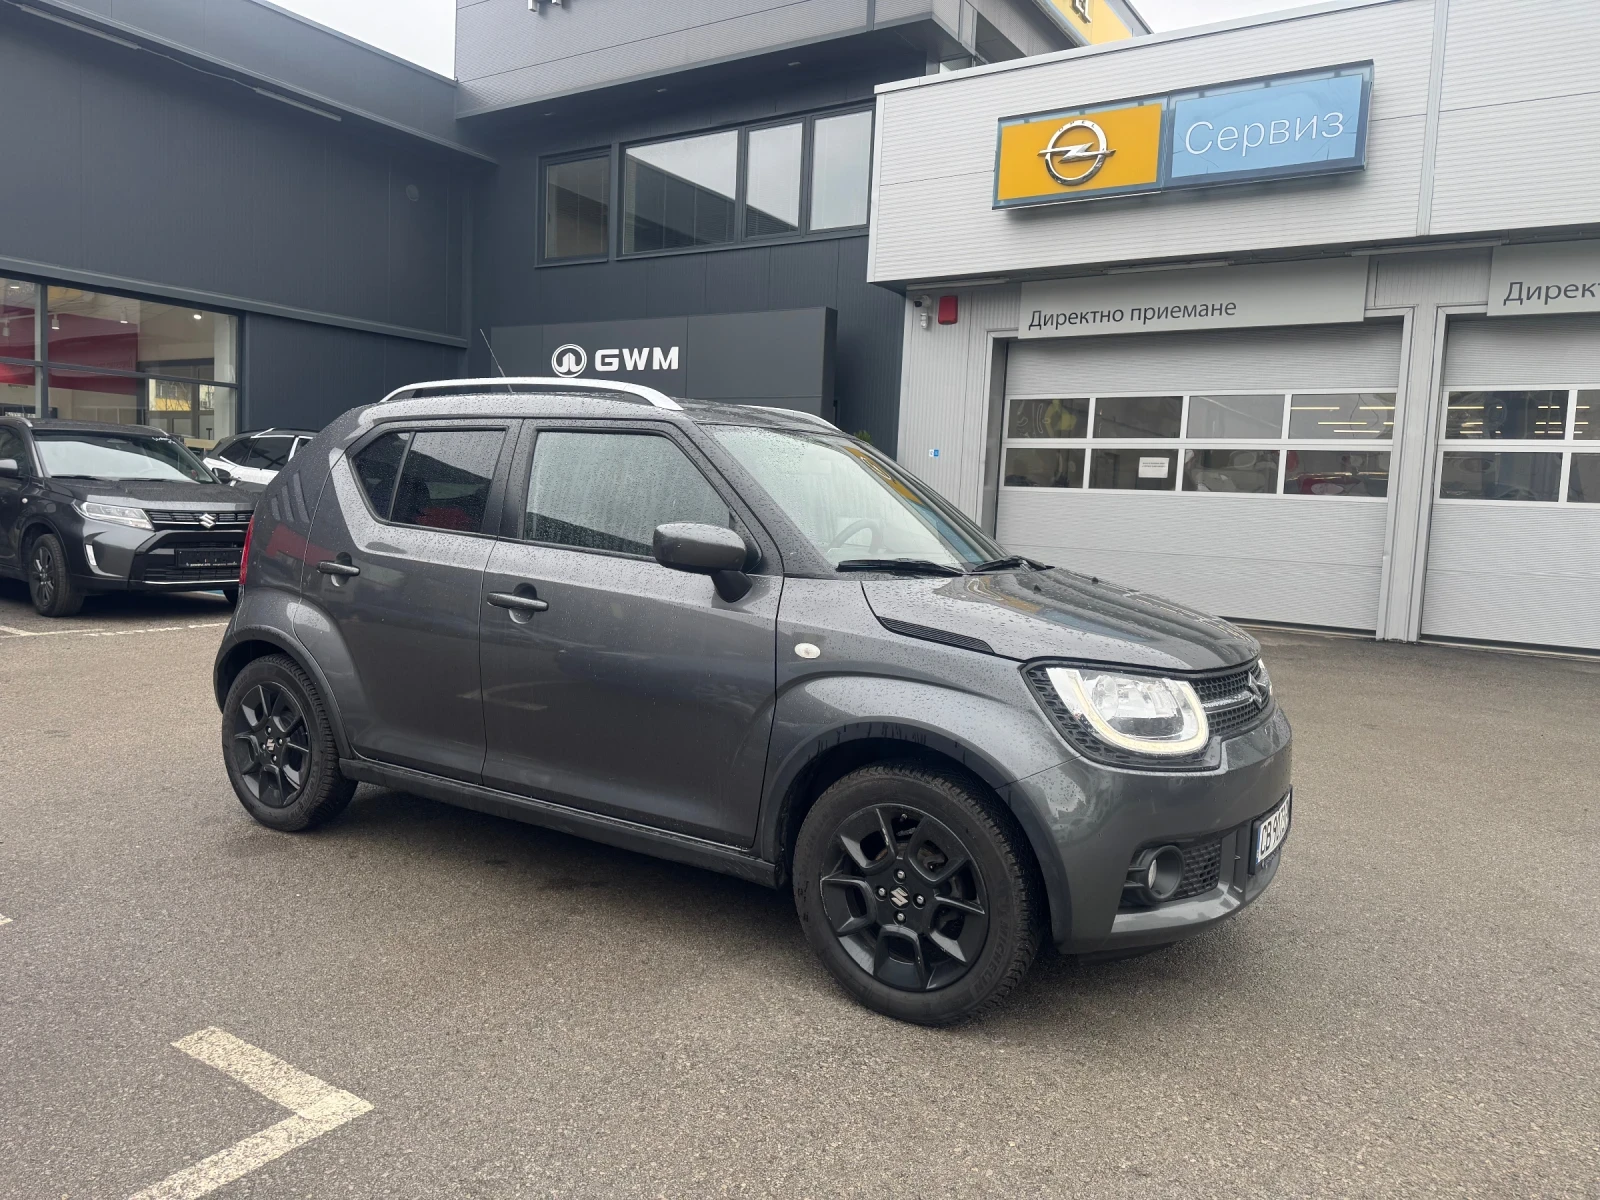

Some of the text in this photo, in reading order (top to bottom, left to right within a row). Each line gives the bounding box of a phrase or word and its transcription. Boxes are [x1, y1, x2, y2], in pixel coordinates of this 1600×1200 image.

[1185, 112, 1344, 157] Сервиз
[1028, 301, 1237, 331] Директно приемане
[594, 346, 680, 372] GWM
[971, 919, 1010, 994] MICHELIN
